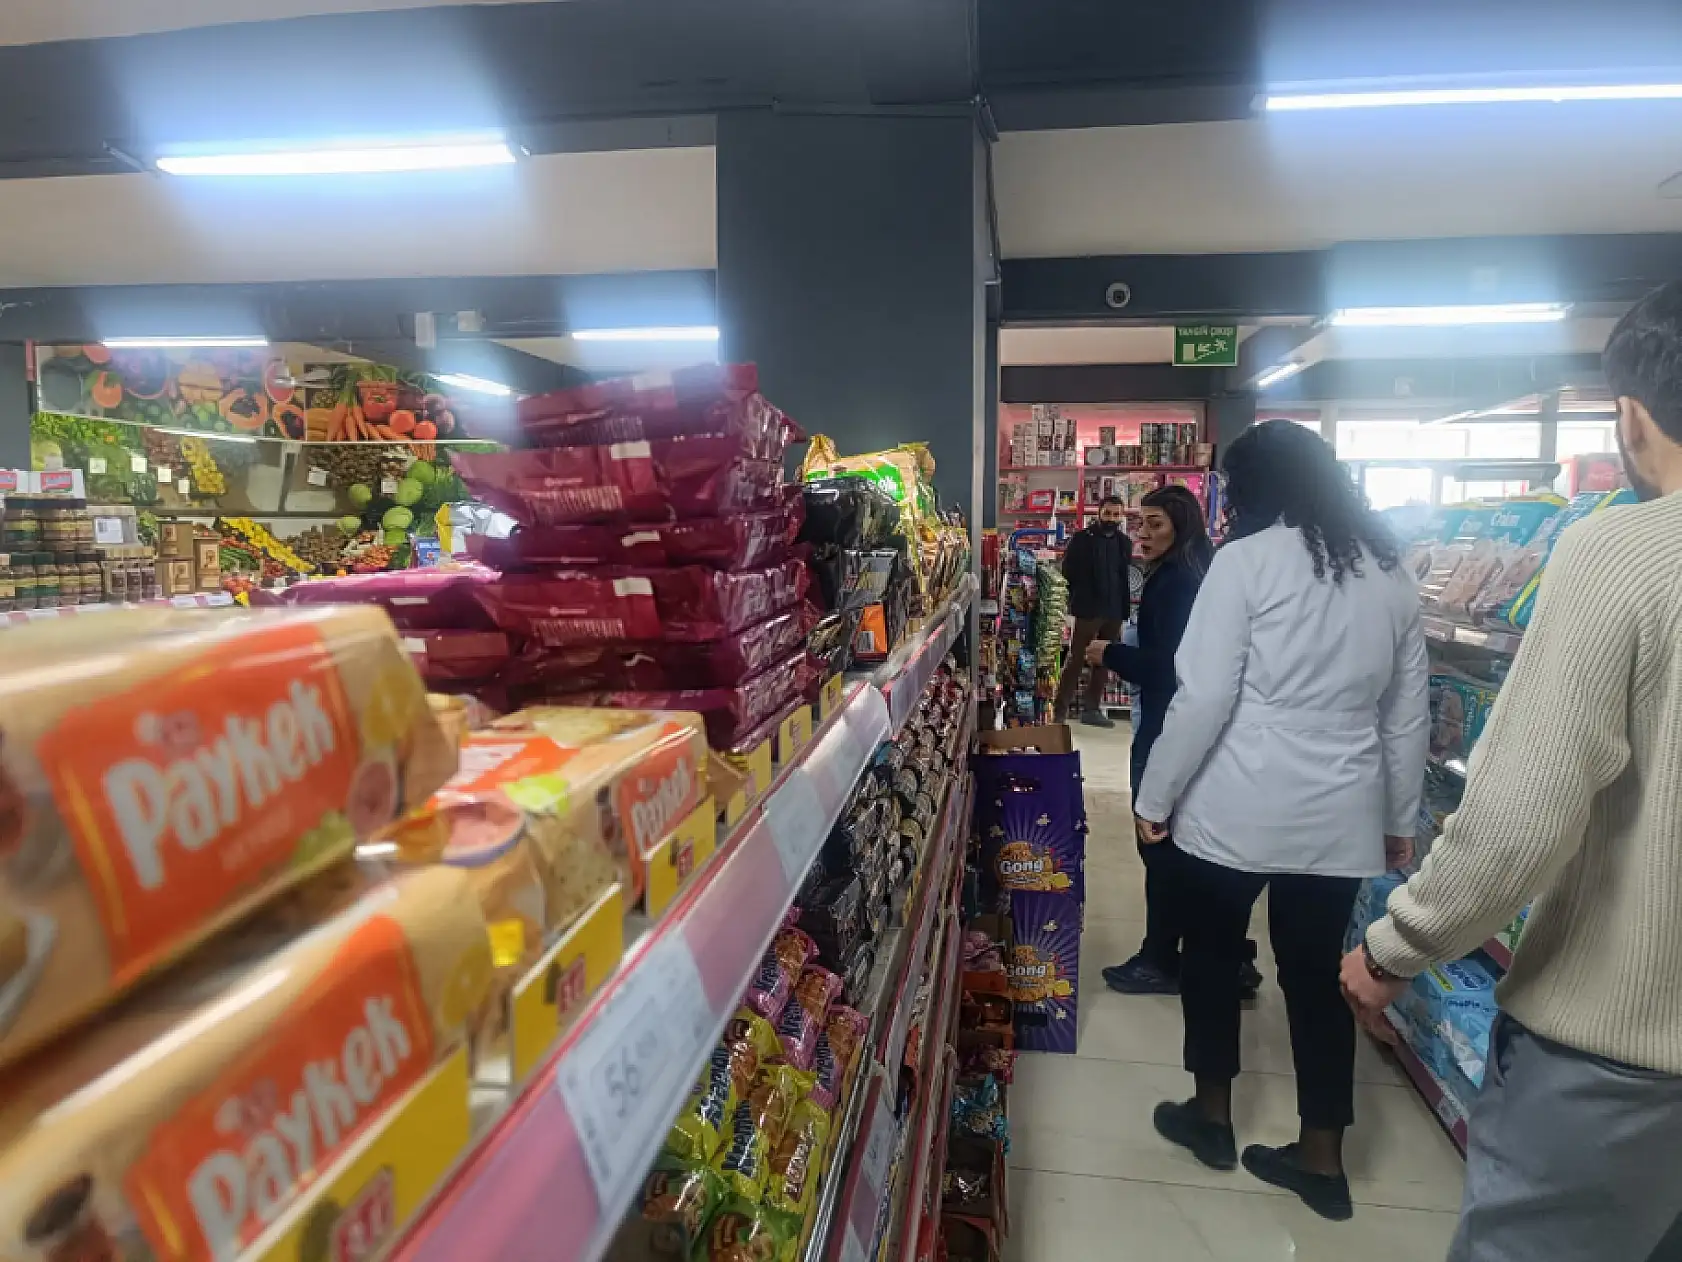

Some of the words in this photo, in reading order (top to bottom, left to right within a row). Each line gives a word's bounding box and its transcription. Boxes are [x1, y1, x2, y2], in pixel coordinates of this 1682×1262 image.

[106, 677, 336, 891] Paykek
[1001, 858, 1044, 873] Gong
[188, 994, 412, 1262] Paykek
